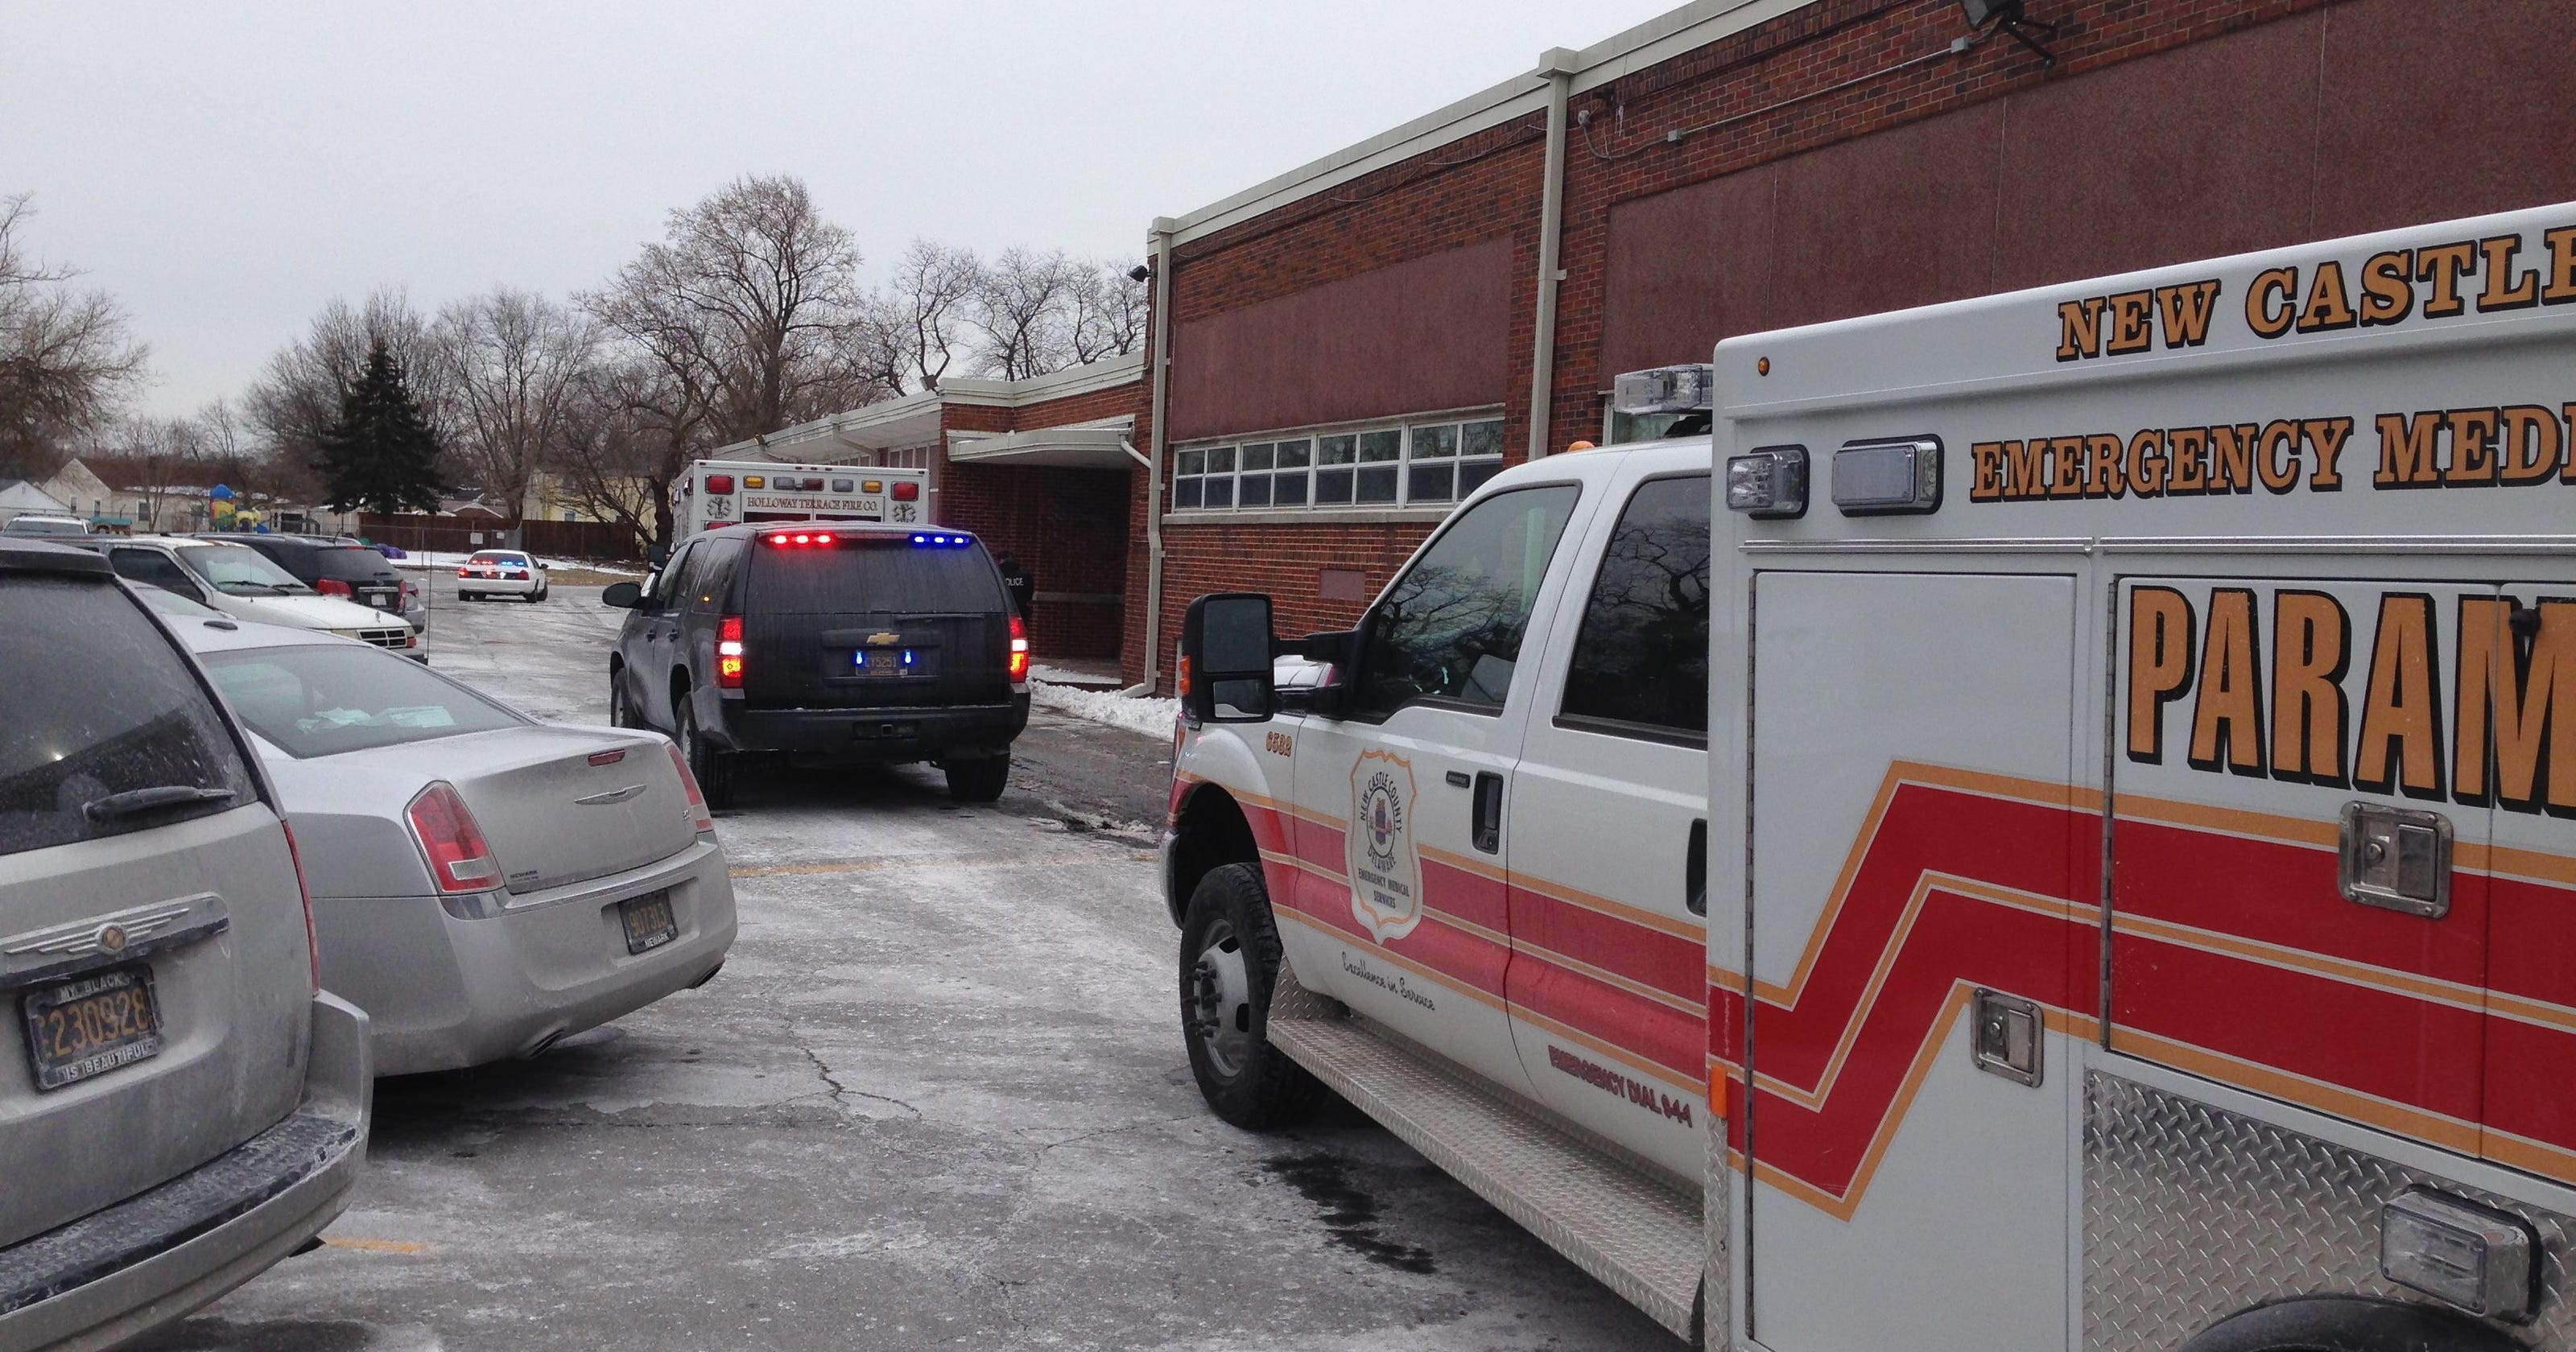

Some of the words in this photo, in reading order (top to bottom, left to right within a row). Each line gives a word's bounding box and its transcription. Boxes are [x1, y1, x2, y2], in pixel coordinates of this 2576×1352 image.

[2055, 278, 2221, 362] NEW
[1969, 415, 2354, 503] EMERGENCY
[747, 497, 797, 509] HOLLOWAY
[799, 498, 840, 509] TERRACE
[842, 500, 861, 510] FIRE
[864, 501, 878, 511] CO.
[1005, 577, 1024, 587] OLICE
[1360, 790, 1369, 821] NEW
[1368, 771, 1389, 792] CASTLE
[1389, 780, 1402, 835] COUNTY
[1368, 845, 1397, 873] DELAWARE
[1358, 868, 1386, 888] EMERGENCY
[1387, 878, 1410, 897] MEDICAL
[1373, 890, 1396, 909] SERVICES
[644, 932, 670, 948] NEWARK
[60, 985, 76, 1001] MY
[1341, 950, 1386, 989] Excellence
[1387, 976, 1398, 994] in
[1399, 976, 1435, 1011] Service
[48, 987, 149, 1057] 230928
[65, 1066, 79, 1080] IS
[83, 1042, 150, 1074] BEAUTIFUL
[1547, 1045, 1625, 1098] EMERGENCY
[1626, 1078, 1662, 1115] DIAL
